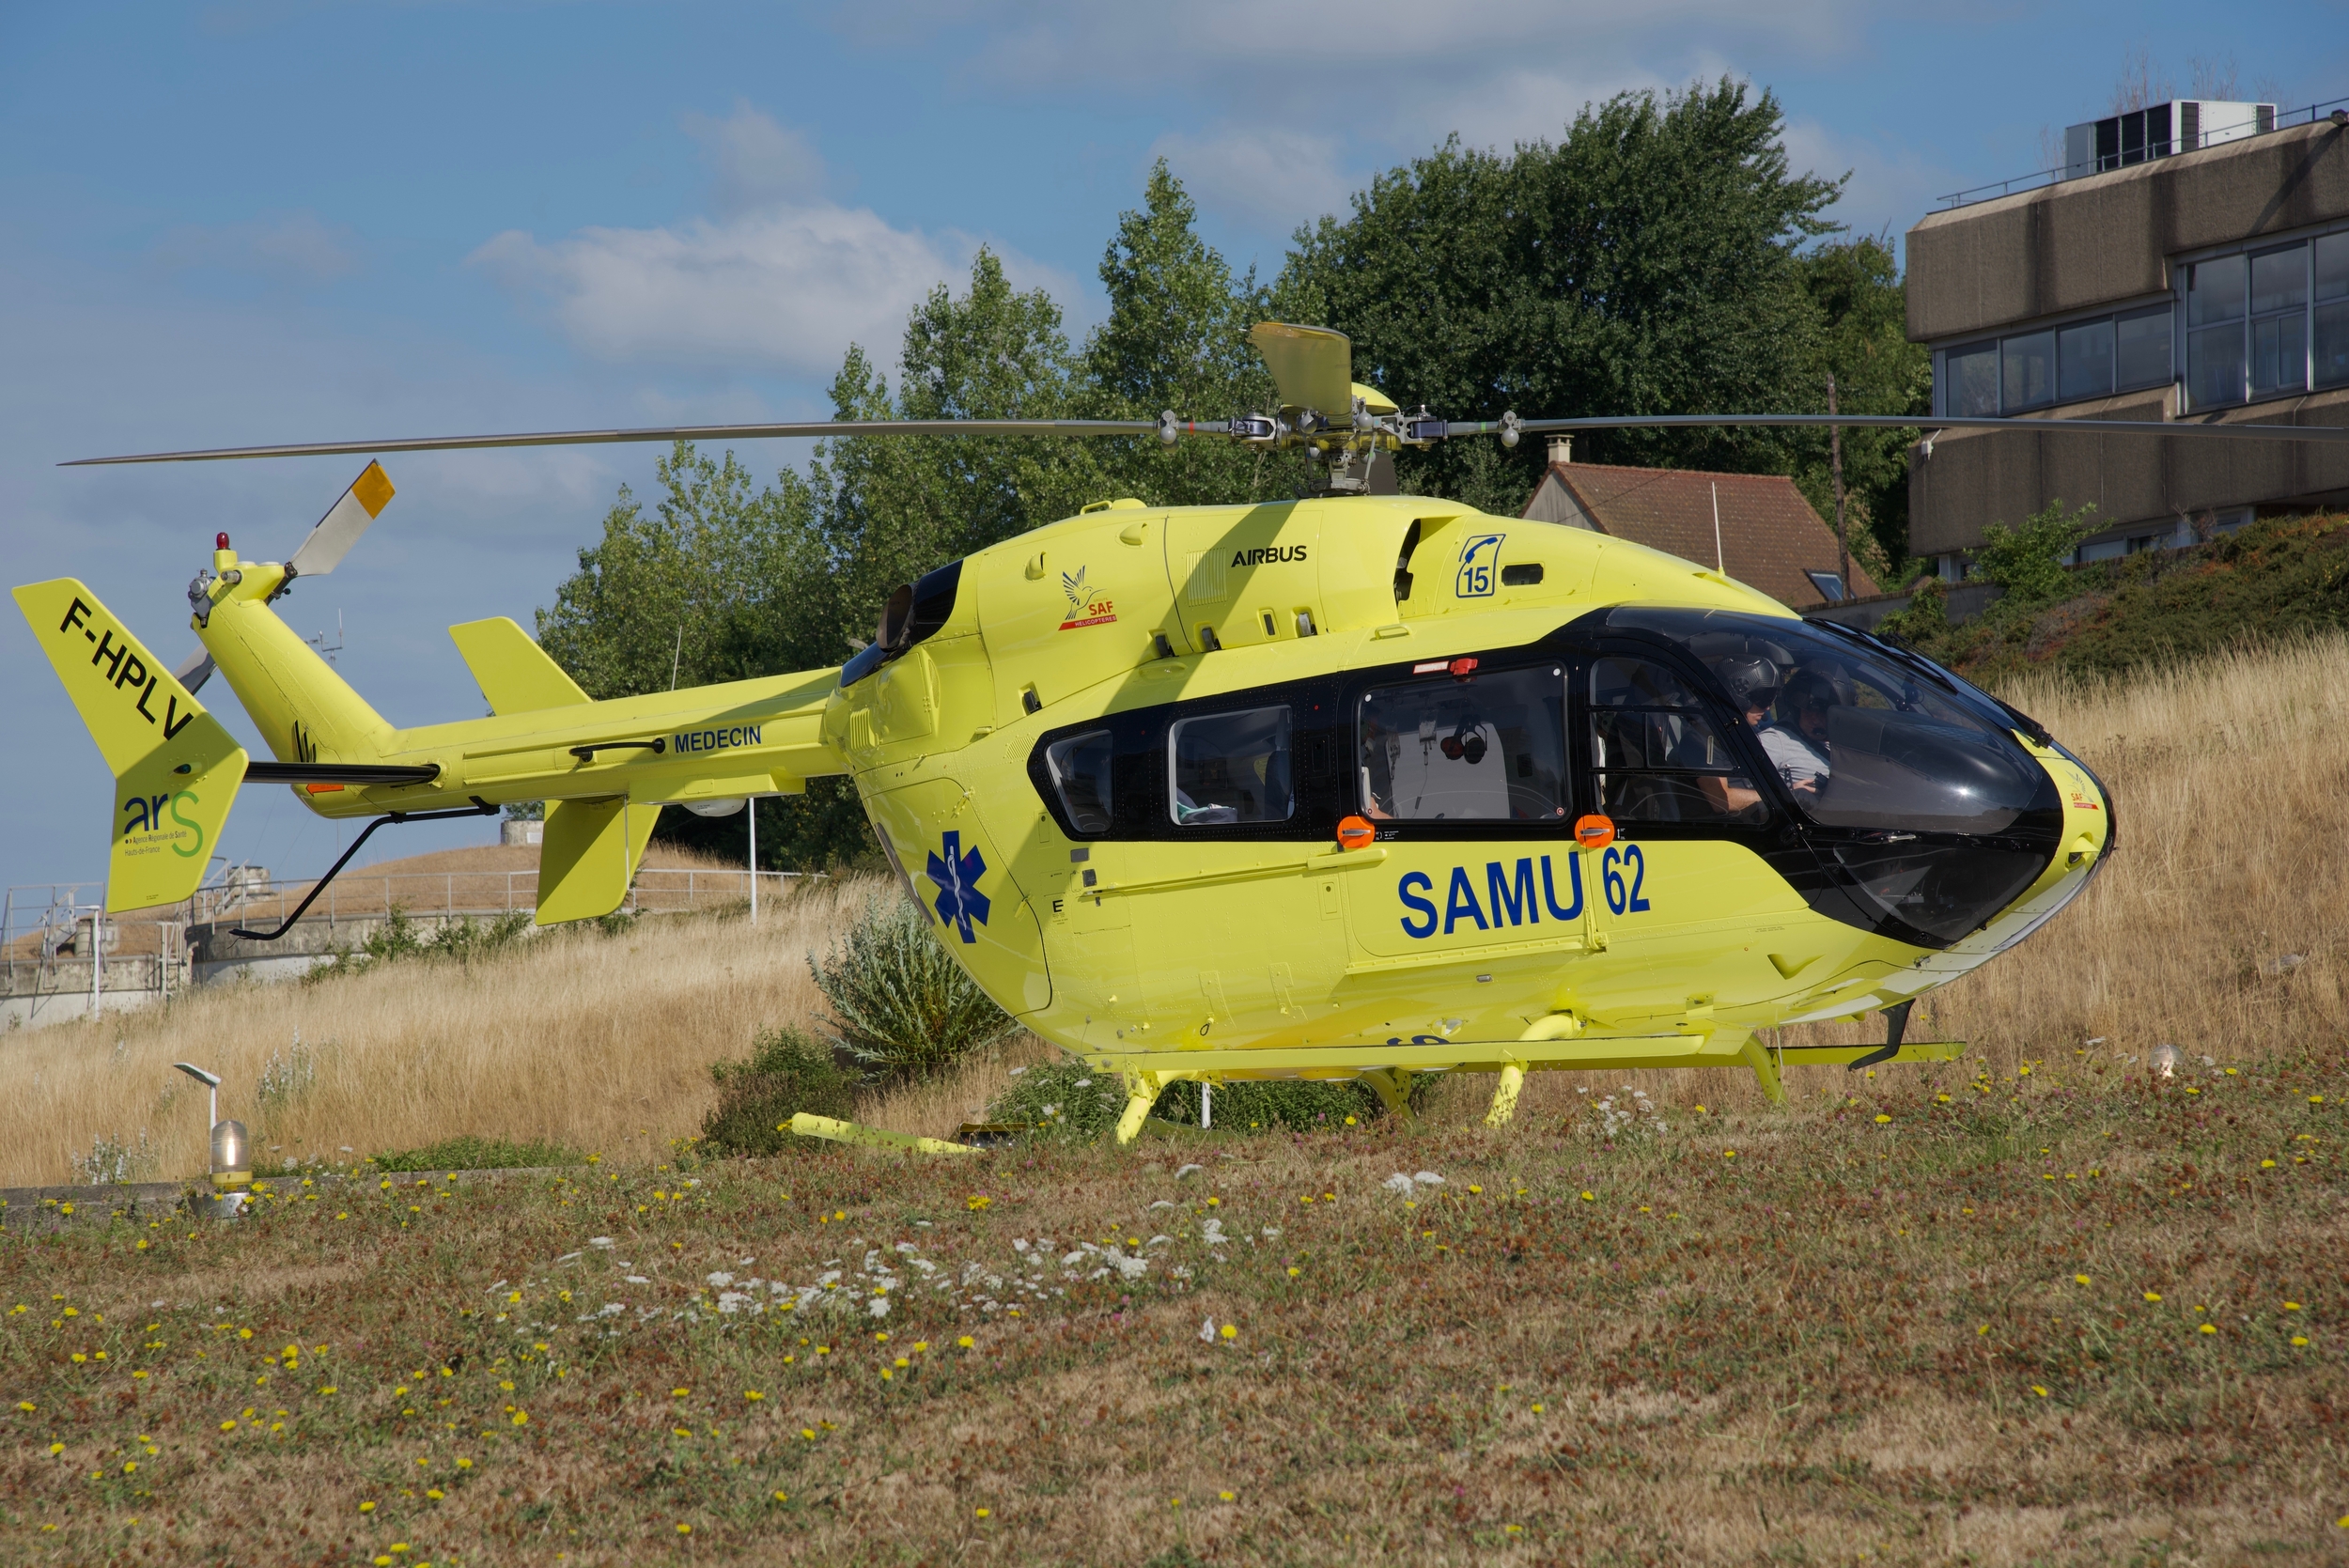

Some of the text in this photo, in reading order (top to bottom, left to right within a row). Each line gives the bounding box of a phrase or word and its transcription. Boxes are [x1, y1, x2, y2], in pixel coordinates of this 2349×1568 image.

[1231, 545, 1307, 567] AIRBUS
[1464, 567, 1488, 593] 15
[1088, 601, 1113, 615] SAF
[1075, 615, 1116, 627] HELICOPTERES
[59, 597, 194, 741] F-HPLV
[675, 725, 761, 753] MEDECIN
[2070, 793, 2082, 801] SAF
[132, 836, 148, 845] Agence
[148, 832, 169, 843] Régionale
[175, 830, 187, 839] Santé
[125, 846, 161, 856] Hauts-de-France
[1398, 844, 1650, 939] SAMU 62
[1052, 899, 1064, 913] E
